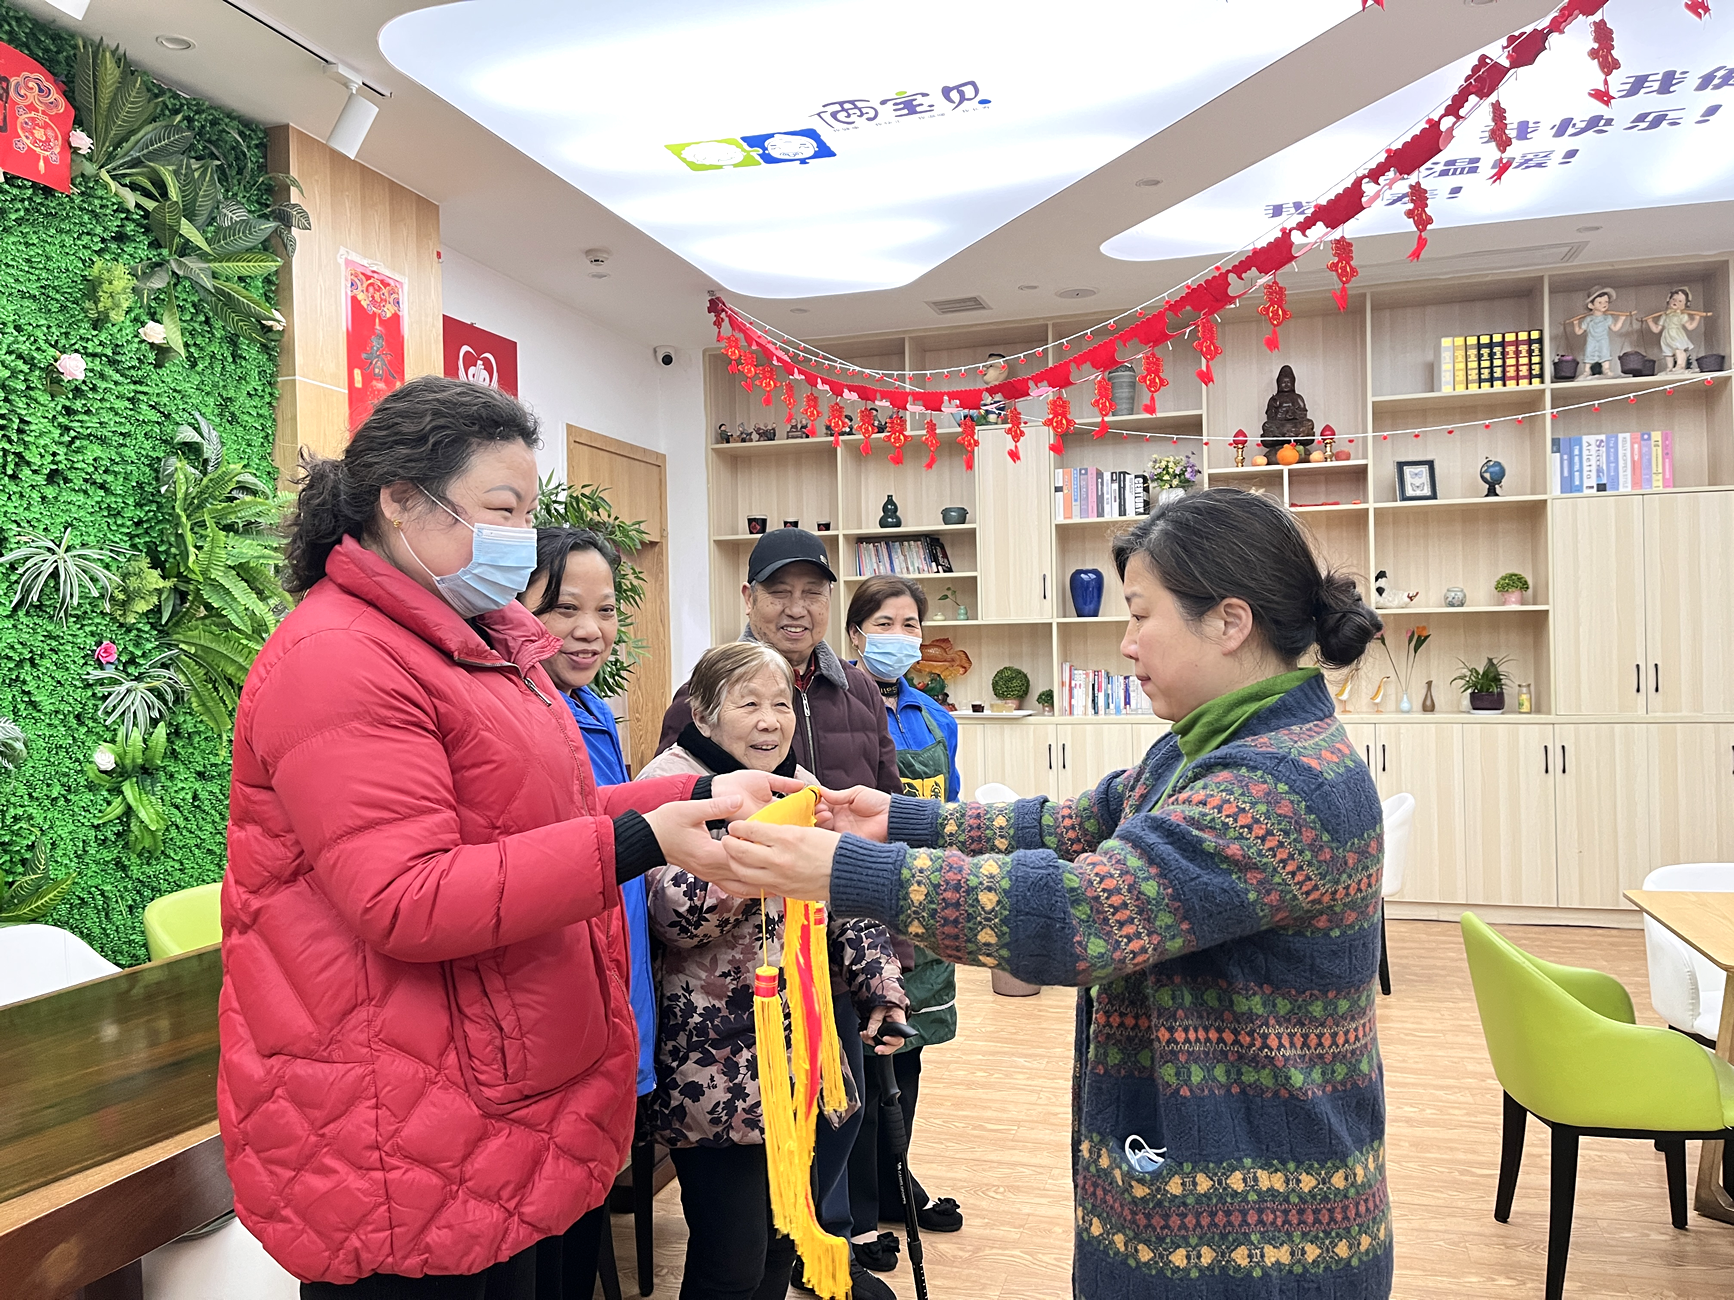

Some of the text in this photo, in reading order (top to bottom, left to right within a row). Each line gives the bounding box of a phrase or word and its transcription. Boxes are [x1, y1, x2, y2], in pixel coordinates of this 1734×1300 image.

[808, 80, 992, 129] 俩宝贝
[1478, 103, 1723, 145] 我快乐!
[1362, 148, 1580, 185] 温暖!
[1134, 477, 1144, 513] CENTURY
